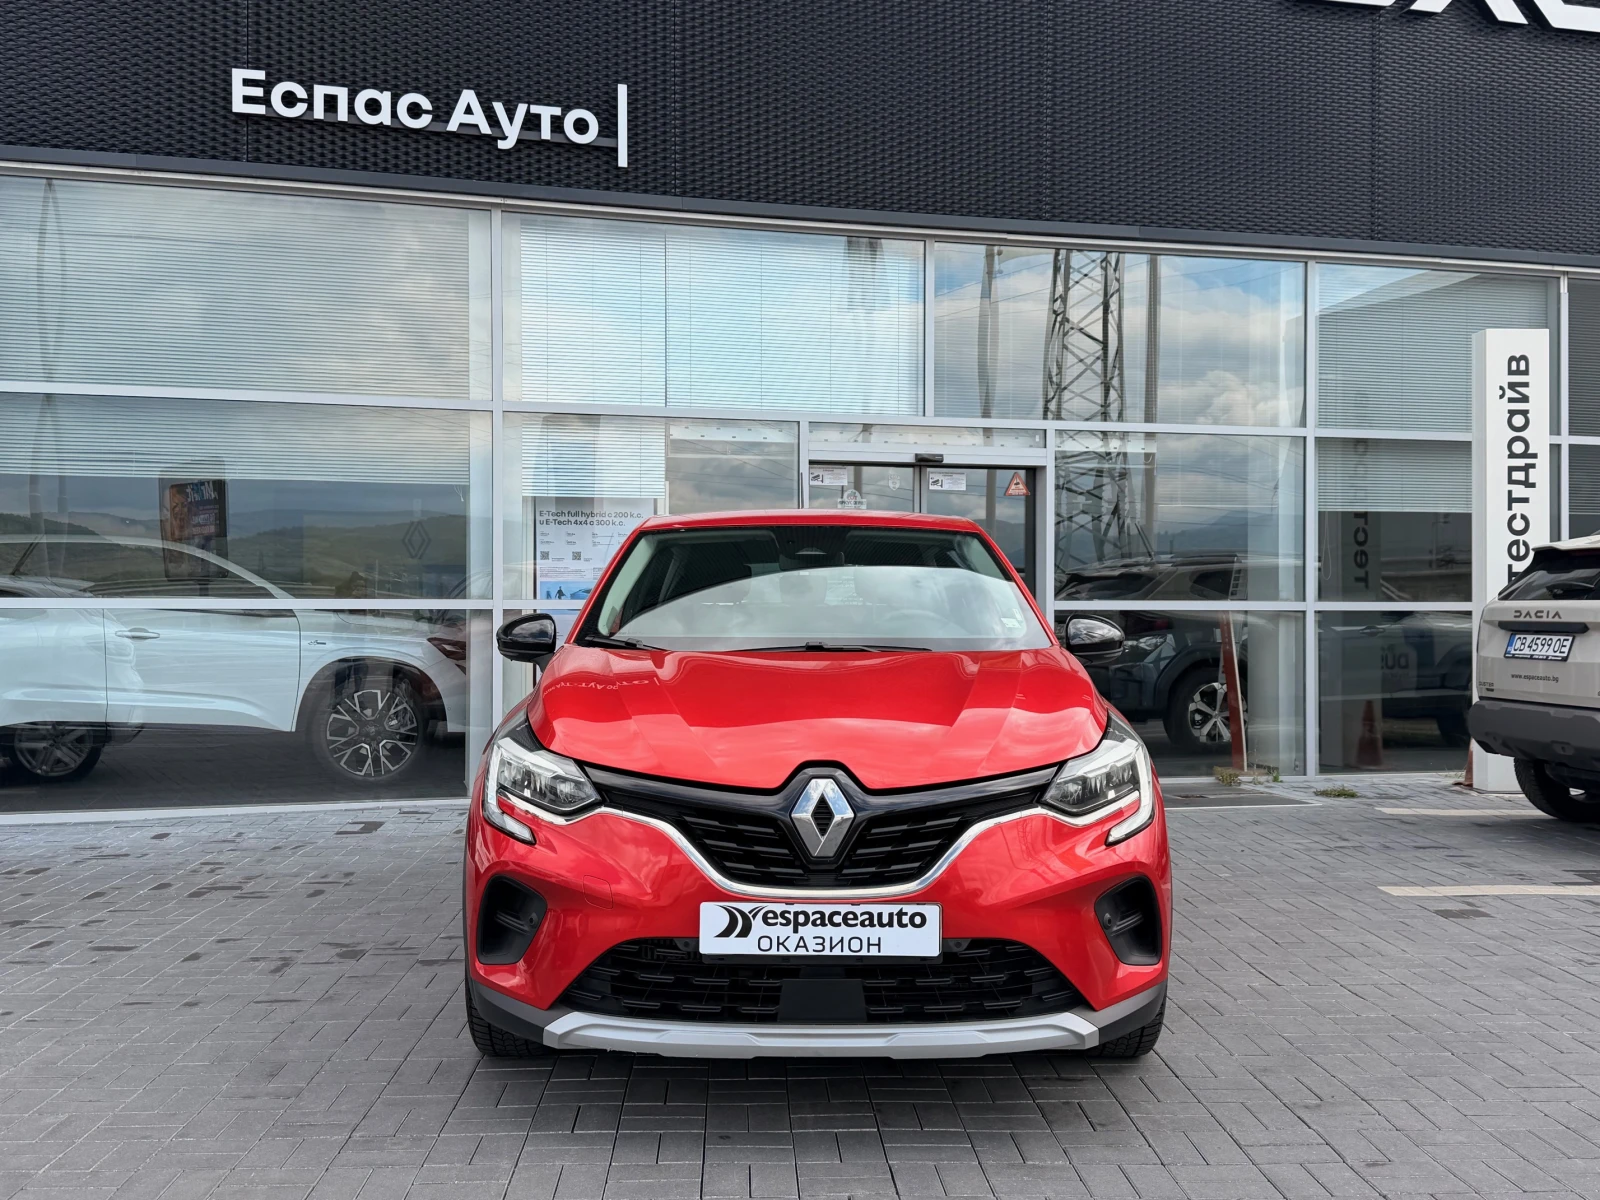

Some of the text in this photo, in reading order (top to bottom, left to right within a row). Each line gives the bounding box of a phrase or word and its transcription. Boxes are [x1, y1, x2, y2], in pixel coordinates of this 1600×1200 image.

[231, 68, 599, 150] Еспас Ауто
[567, 510, 580, 518] full
[581, 510, 607, 519] hybrid
[545, 518, 573, 526] E-Tech
[1513, 610, 1562, 619] DACIA
[1527, 637, 1553, 652] 4599
[1511, 673, 1559, 683] www.espaceauto.bg
[761, 907, 927, 934] espaceauto
[757, 935, 881, 953] ОКАЗИОН
